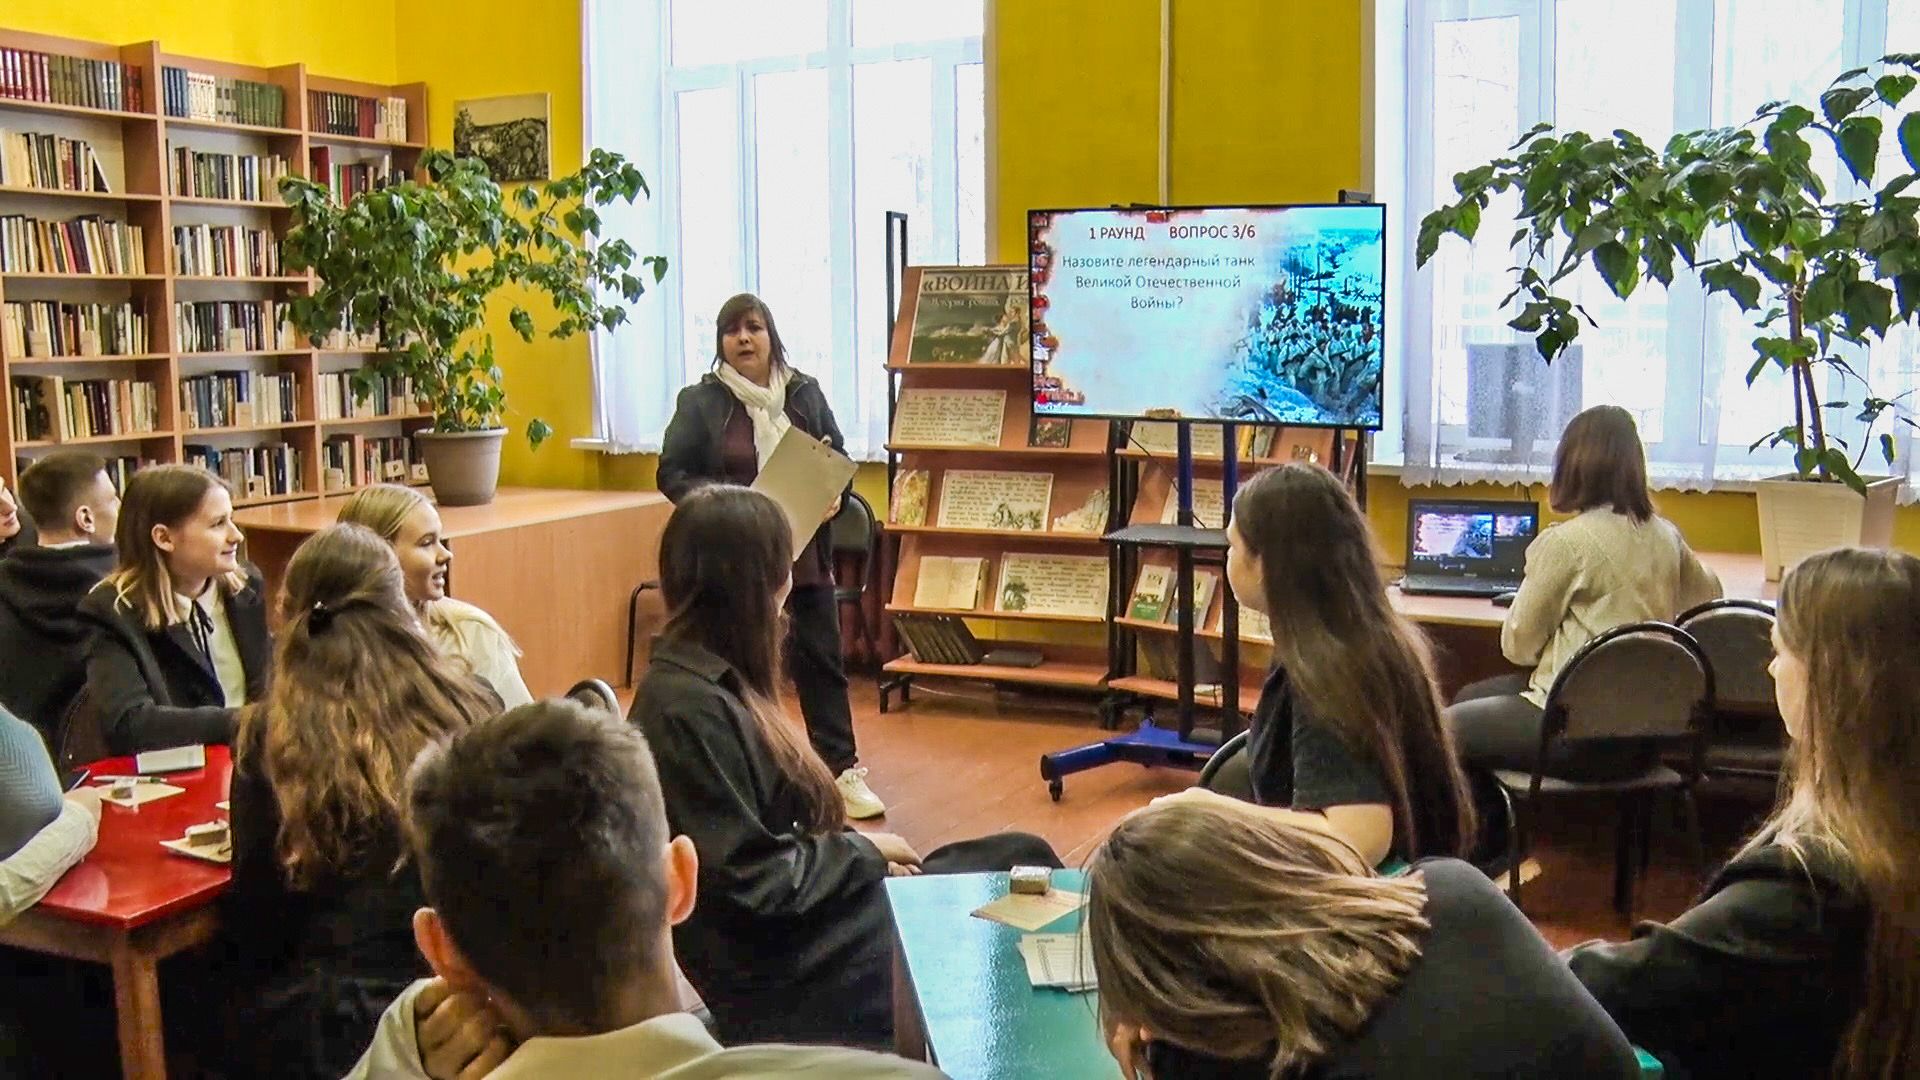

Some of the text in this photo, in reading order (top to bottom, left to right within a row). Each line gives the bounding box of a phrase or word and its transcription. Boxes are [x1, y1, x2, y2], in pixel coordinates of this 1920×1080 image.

[1089, 223, 1256, 241] 1 РАУНД ВОПРОС 3/6
[1062, 253, 1256, 270] Назовите легендарный танк
[923, 273, 1010, 292] «ВОЙНА
[1075, 274, 1242, 289] Великой Отечественной
[1130, 295, 1184, 310] Войны?
